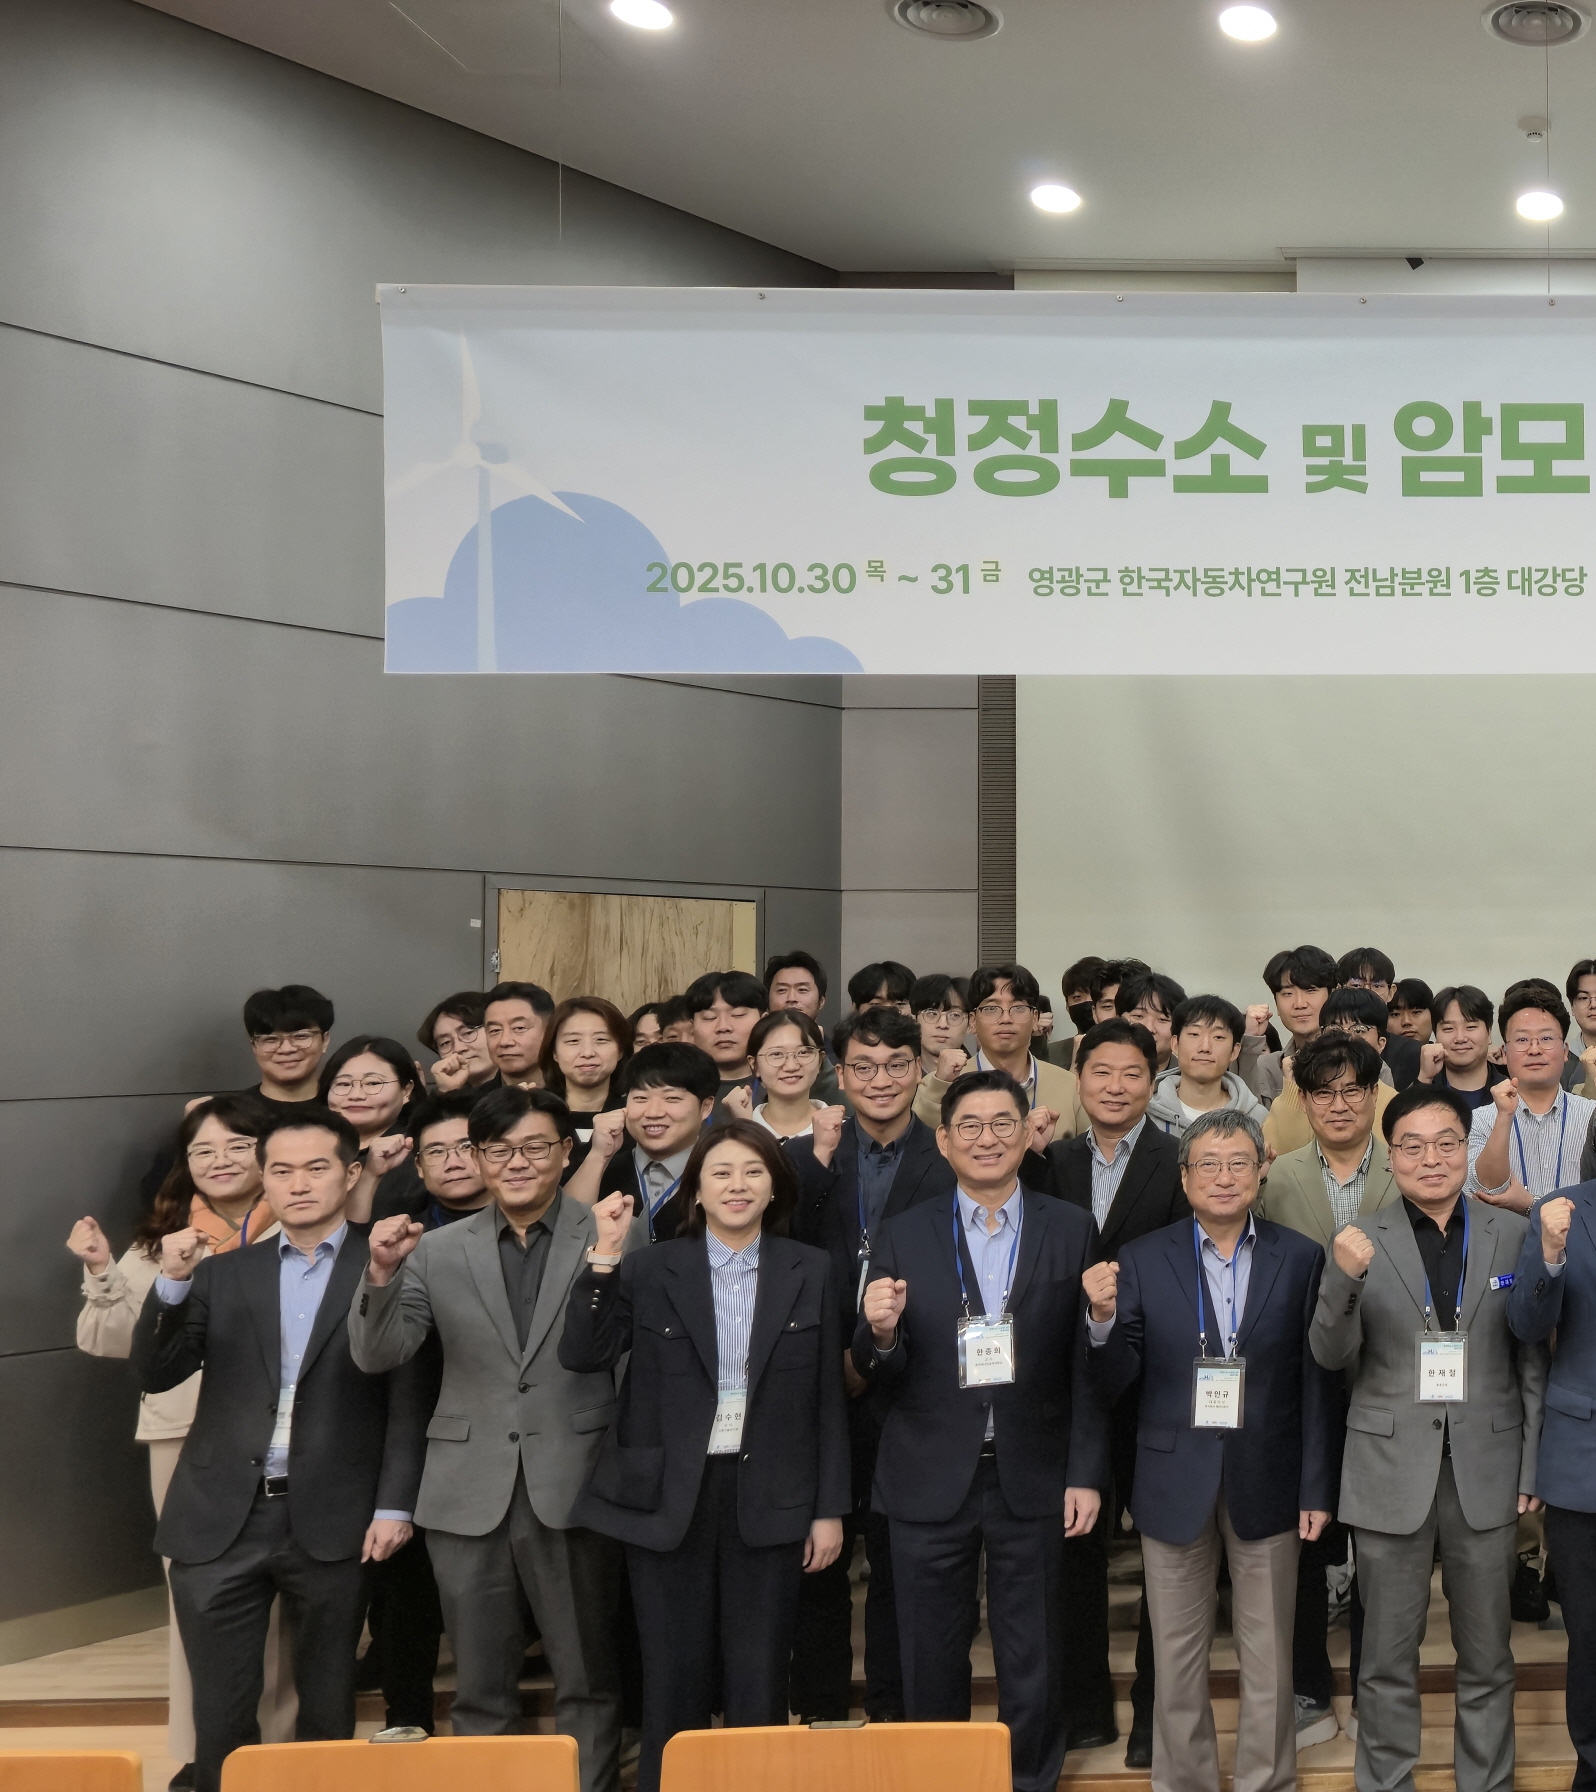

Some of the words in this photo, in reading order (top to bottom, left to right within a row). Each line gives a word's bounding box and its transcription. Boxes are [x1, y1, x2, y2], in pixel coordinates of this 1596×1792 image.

[864, 396, 1268, 498] 청정수소
[1301, 423, 1369, 494] 및
[645, 561, 857, 595] 2025.10.30
[866, 560, 886, 582] 목
[930, 563, 970, 595] 31
[981, 560, 1002, 582] 금
[1028, 565, 1112, 597] 영광군
[1117, 565, 1337, 598] 한국자동차연구원
[1343, 566, 1452, 597] 전남분원
[1459, 566, 1501, 597] 1층
[1506, 565, 1588, 597] 대강당
